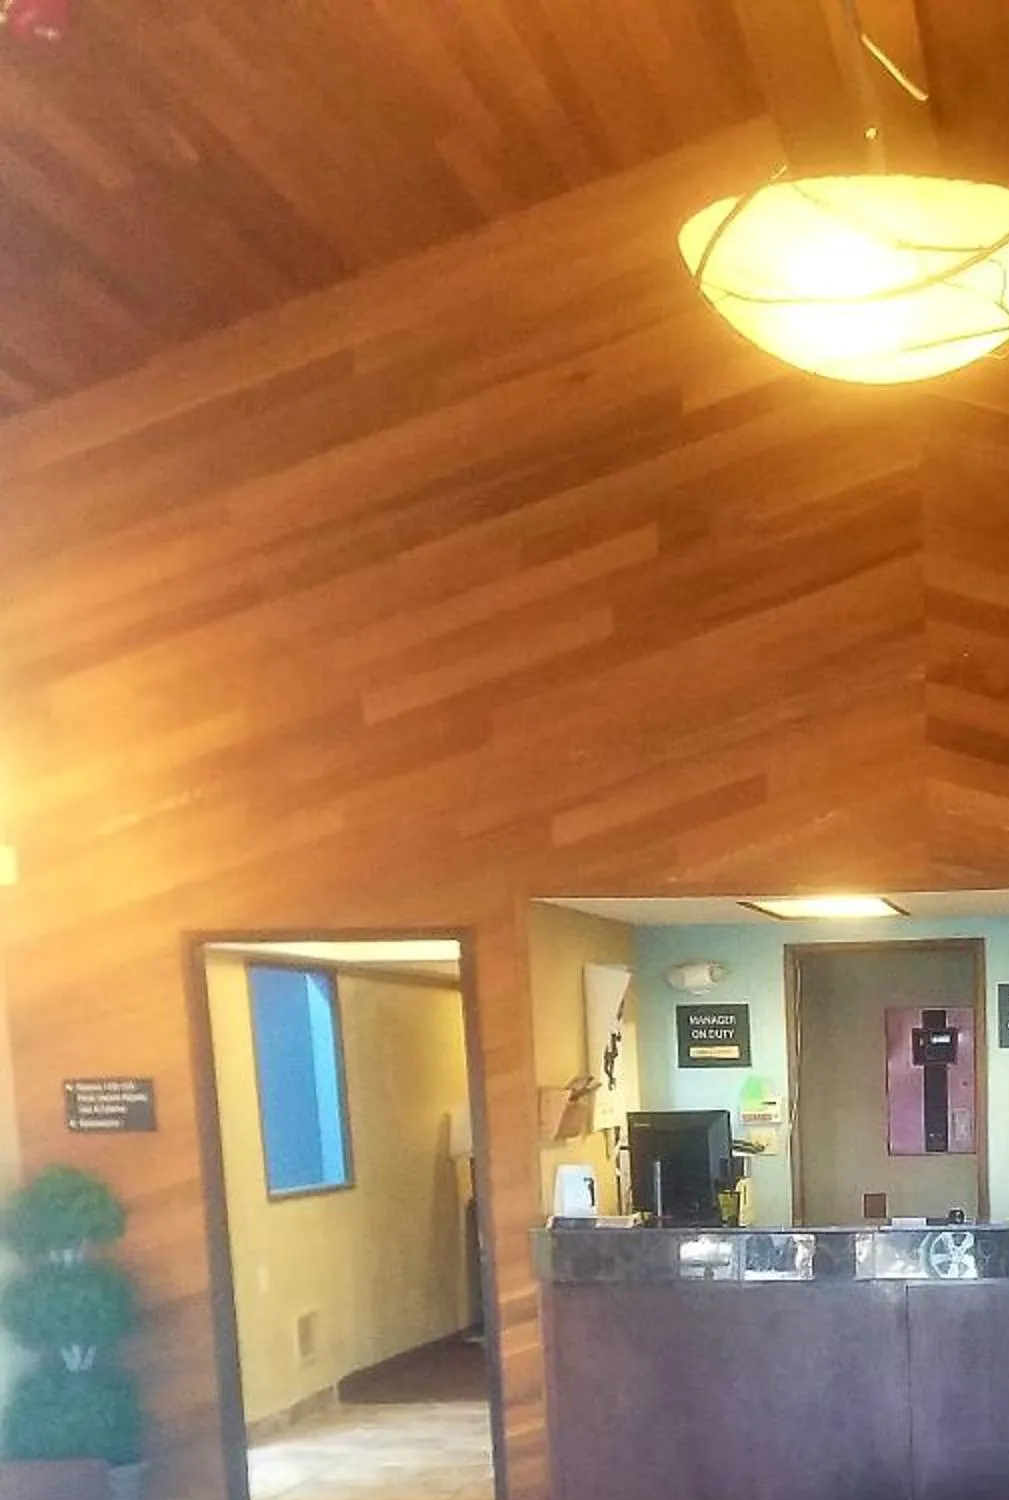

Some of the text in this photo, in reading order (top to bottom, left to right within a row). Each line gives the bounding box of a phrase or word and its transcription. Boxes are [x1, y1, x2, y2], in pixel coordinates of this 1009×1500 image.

[689, 1015, 736, 1025] MANAGER
[691, 1028, 735, 1039] ON DUTY
